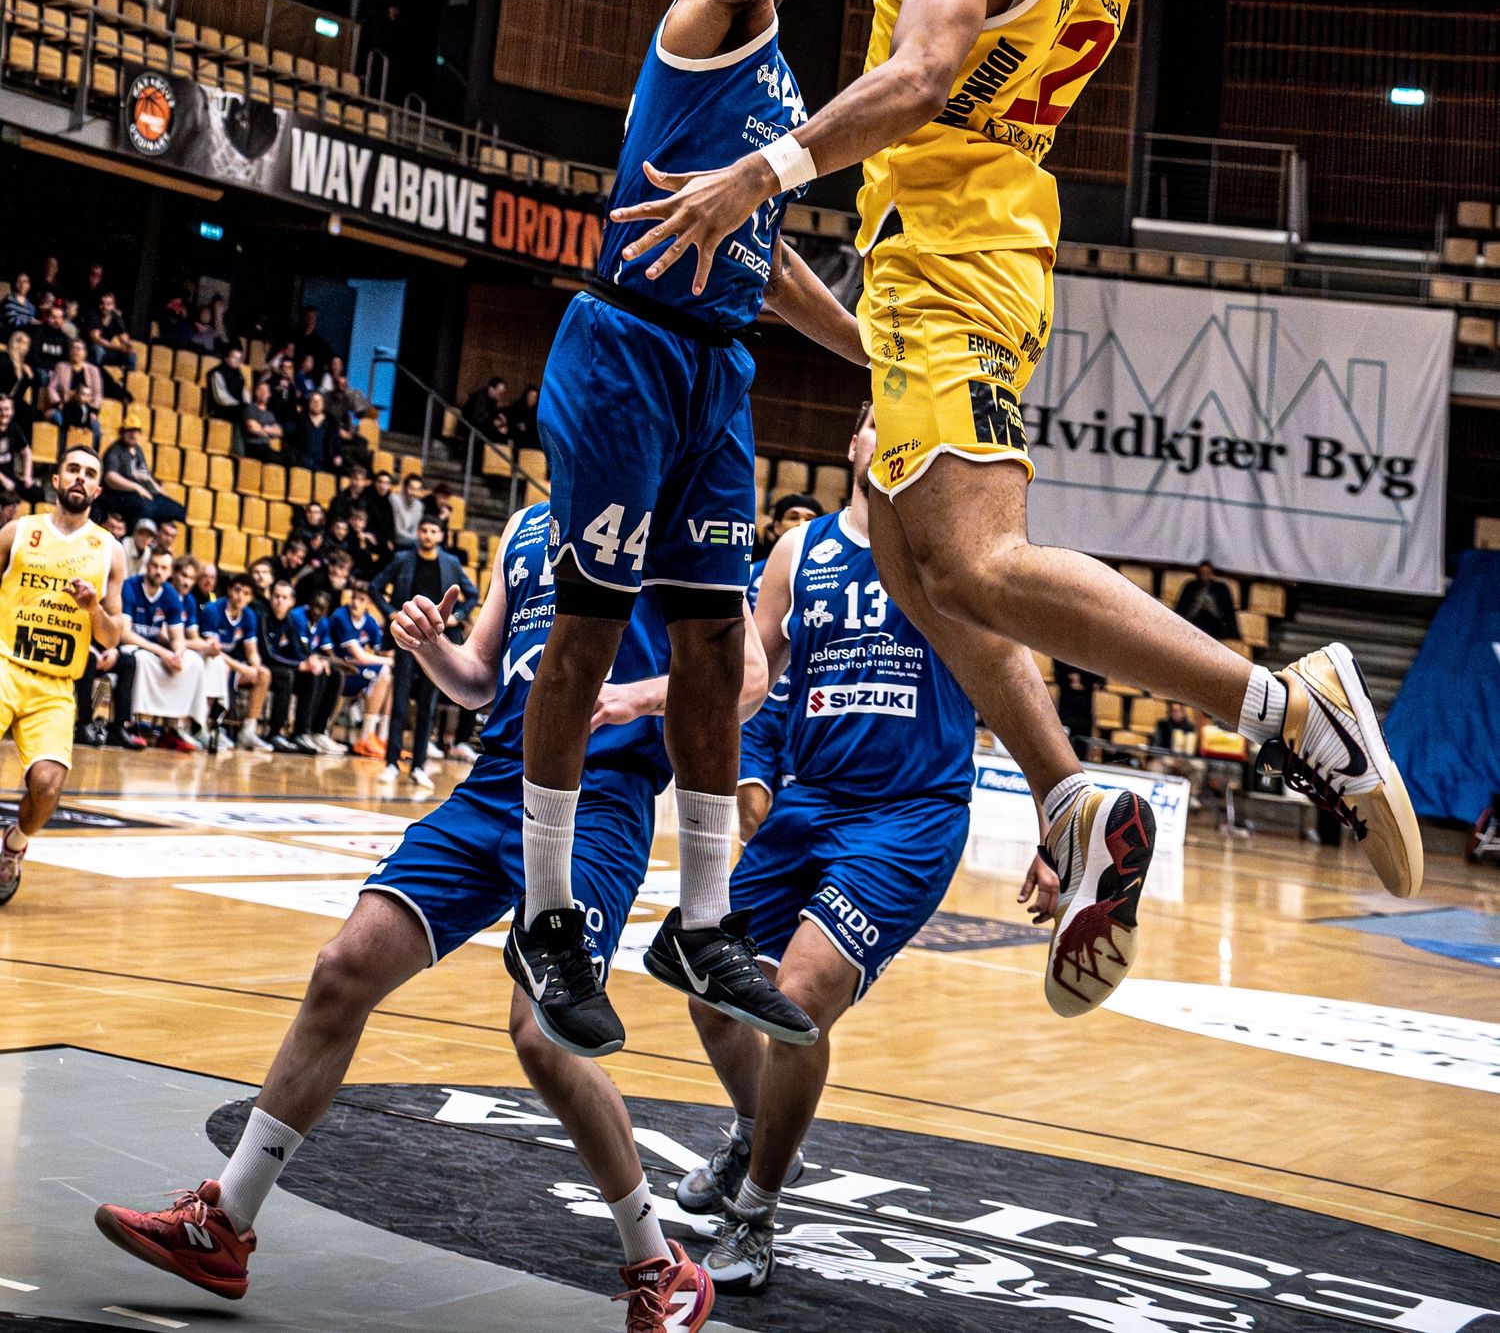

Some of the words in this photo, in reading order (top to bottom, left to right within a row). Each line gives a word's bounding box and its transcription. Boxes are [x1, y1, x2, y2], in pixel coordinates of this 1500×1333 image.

[289, 127, 373, 209] WAY
[371, 153, 488, 243] ABOVE
[881, 442, 911, 462] CRAFT
[1019, 402, 1287, 475] Hvidkjær
[1303, 434, 1418, 501] Byg
[888, 456, 905, 483] 22
[29, 529, 42, 548] 9
[582, 502, 652, 572] 44
[844, 580, 889, 630] 13
[15, 610, 43, 623] Auto
[47, 614, 83, 632] Ekstra
[829, 690, 915, 710] SUZUKI
[814, 885, 880, 947] ERDO
[836, 922, 861, 952] CRAFT
